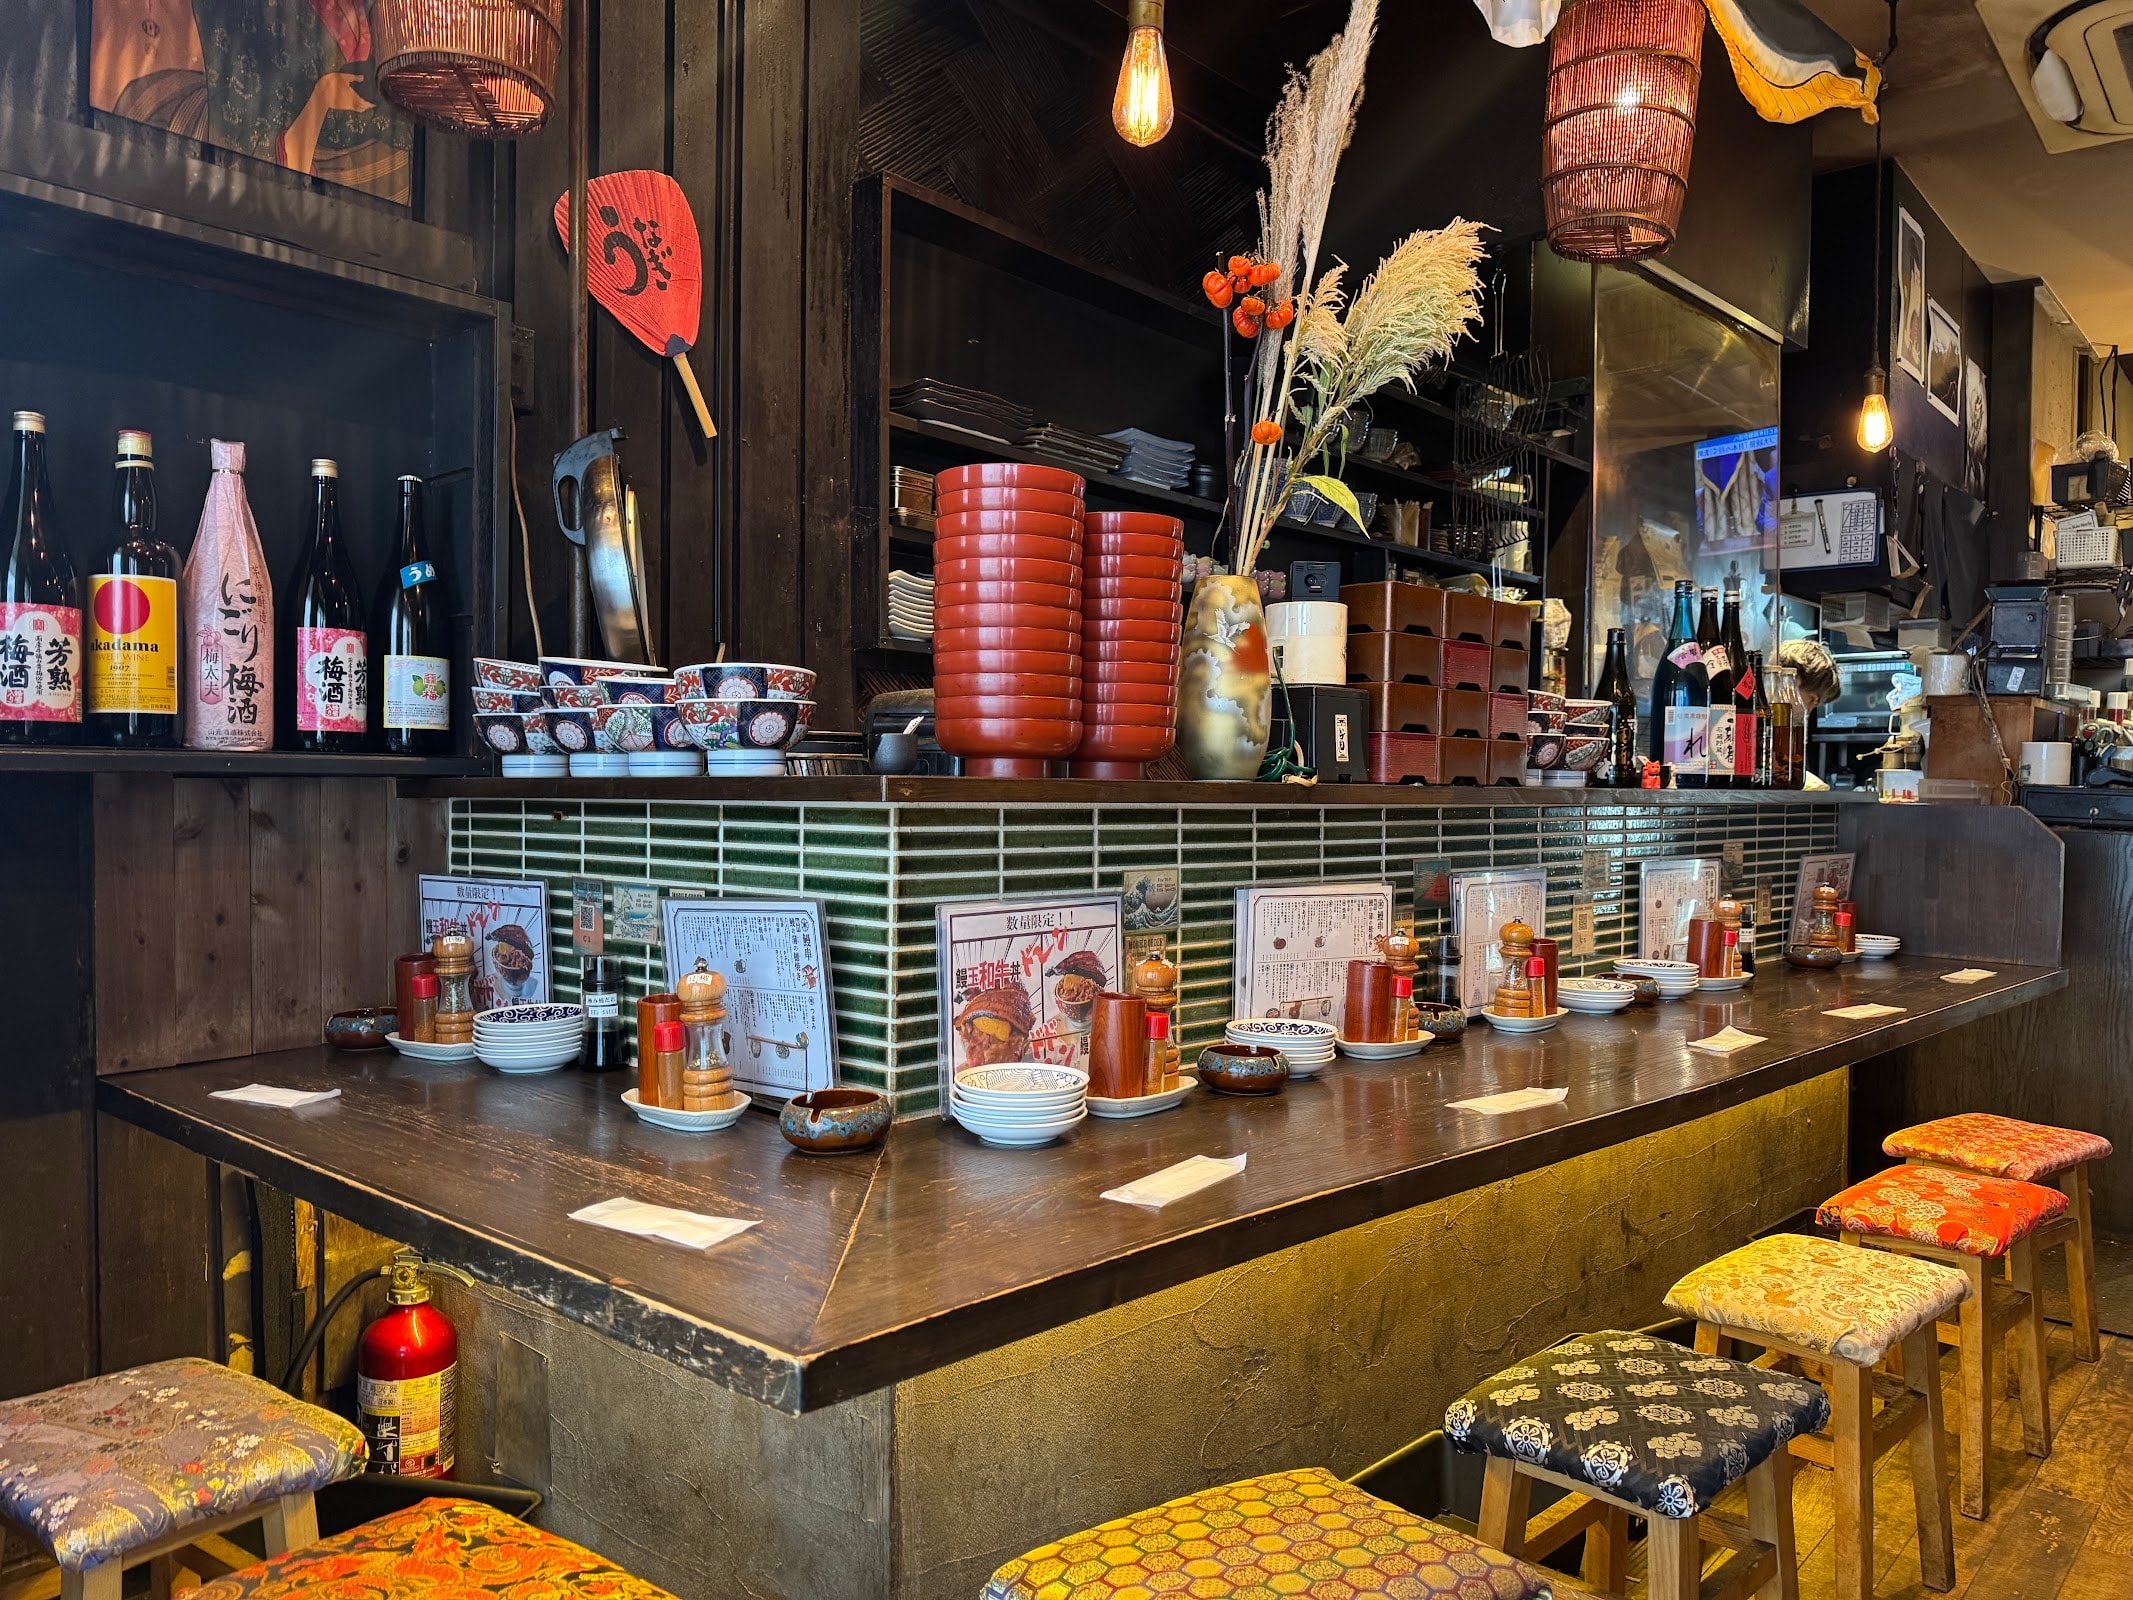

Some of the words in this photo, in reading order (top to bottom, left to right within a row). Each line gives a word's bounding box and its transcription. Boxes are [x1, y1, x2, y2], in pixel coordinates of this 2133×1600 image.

[408, 563, 436, 582] うめ
[0, 634, 34, 689] 梅酒
[44, 637, 74, 692] 芳熟
[123, 653, 151, 662] WINE
[219, 572, 264, 725] にごり梅酒
[110, 664, 130, 672] 1907
[202, 648, 219, 697] 梅太夫
[315, 655, 347, 704] 梅酒
[1683, 728, 1707, 758] れ
[1006, 910, 1074, 932] 数量限定！！
[955, 958, 1021, 992] 鰻玉和牛丼
